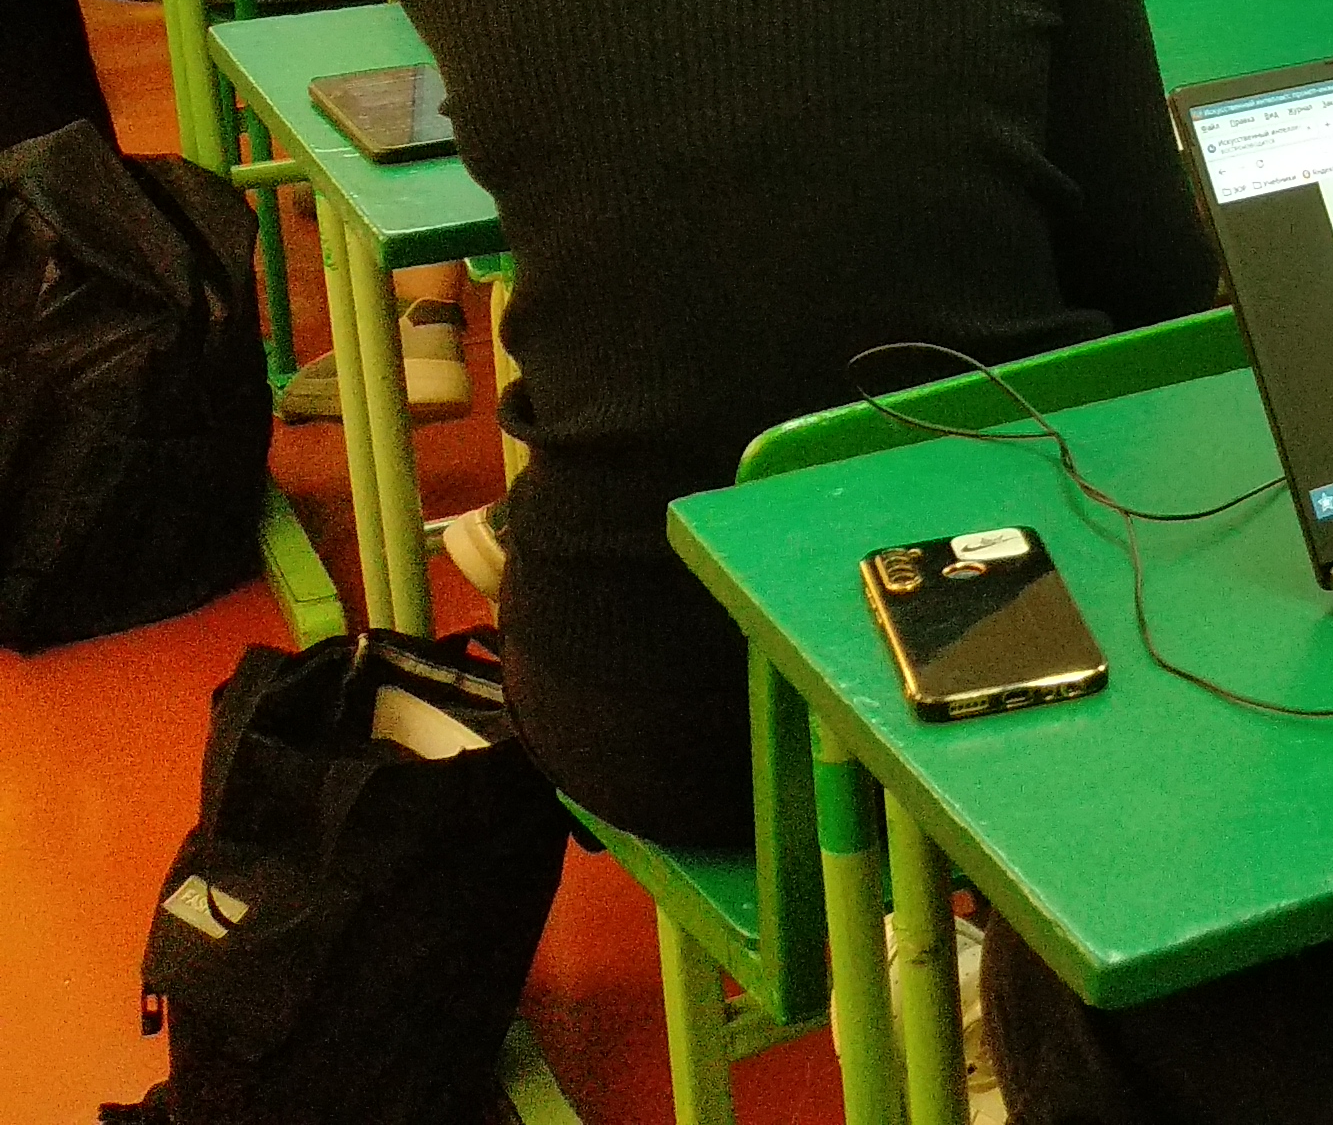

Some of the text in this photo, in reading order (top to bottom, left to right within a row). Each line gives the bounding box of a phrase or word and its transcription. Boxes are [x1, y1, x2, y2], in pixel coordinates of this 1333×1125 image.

[1200, 122, 1221, 134] Файл
[1229, 116, 1256, 128] Правка
[1263, 111, 1280, 121] Вид
[1287, 104, 1314, 116] Журнал
[1217, 130, 1271, 148] Искусственный
[1262, 175, 1298, 188] Учебники
